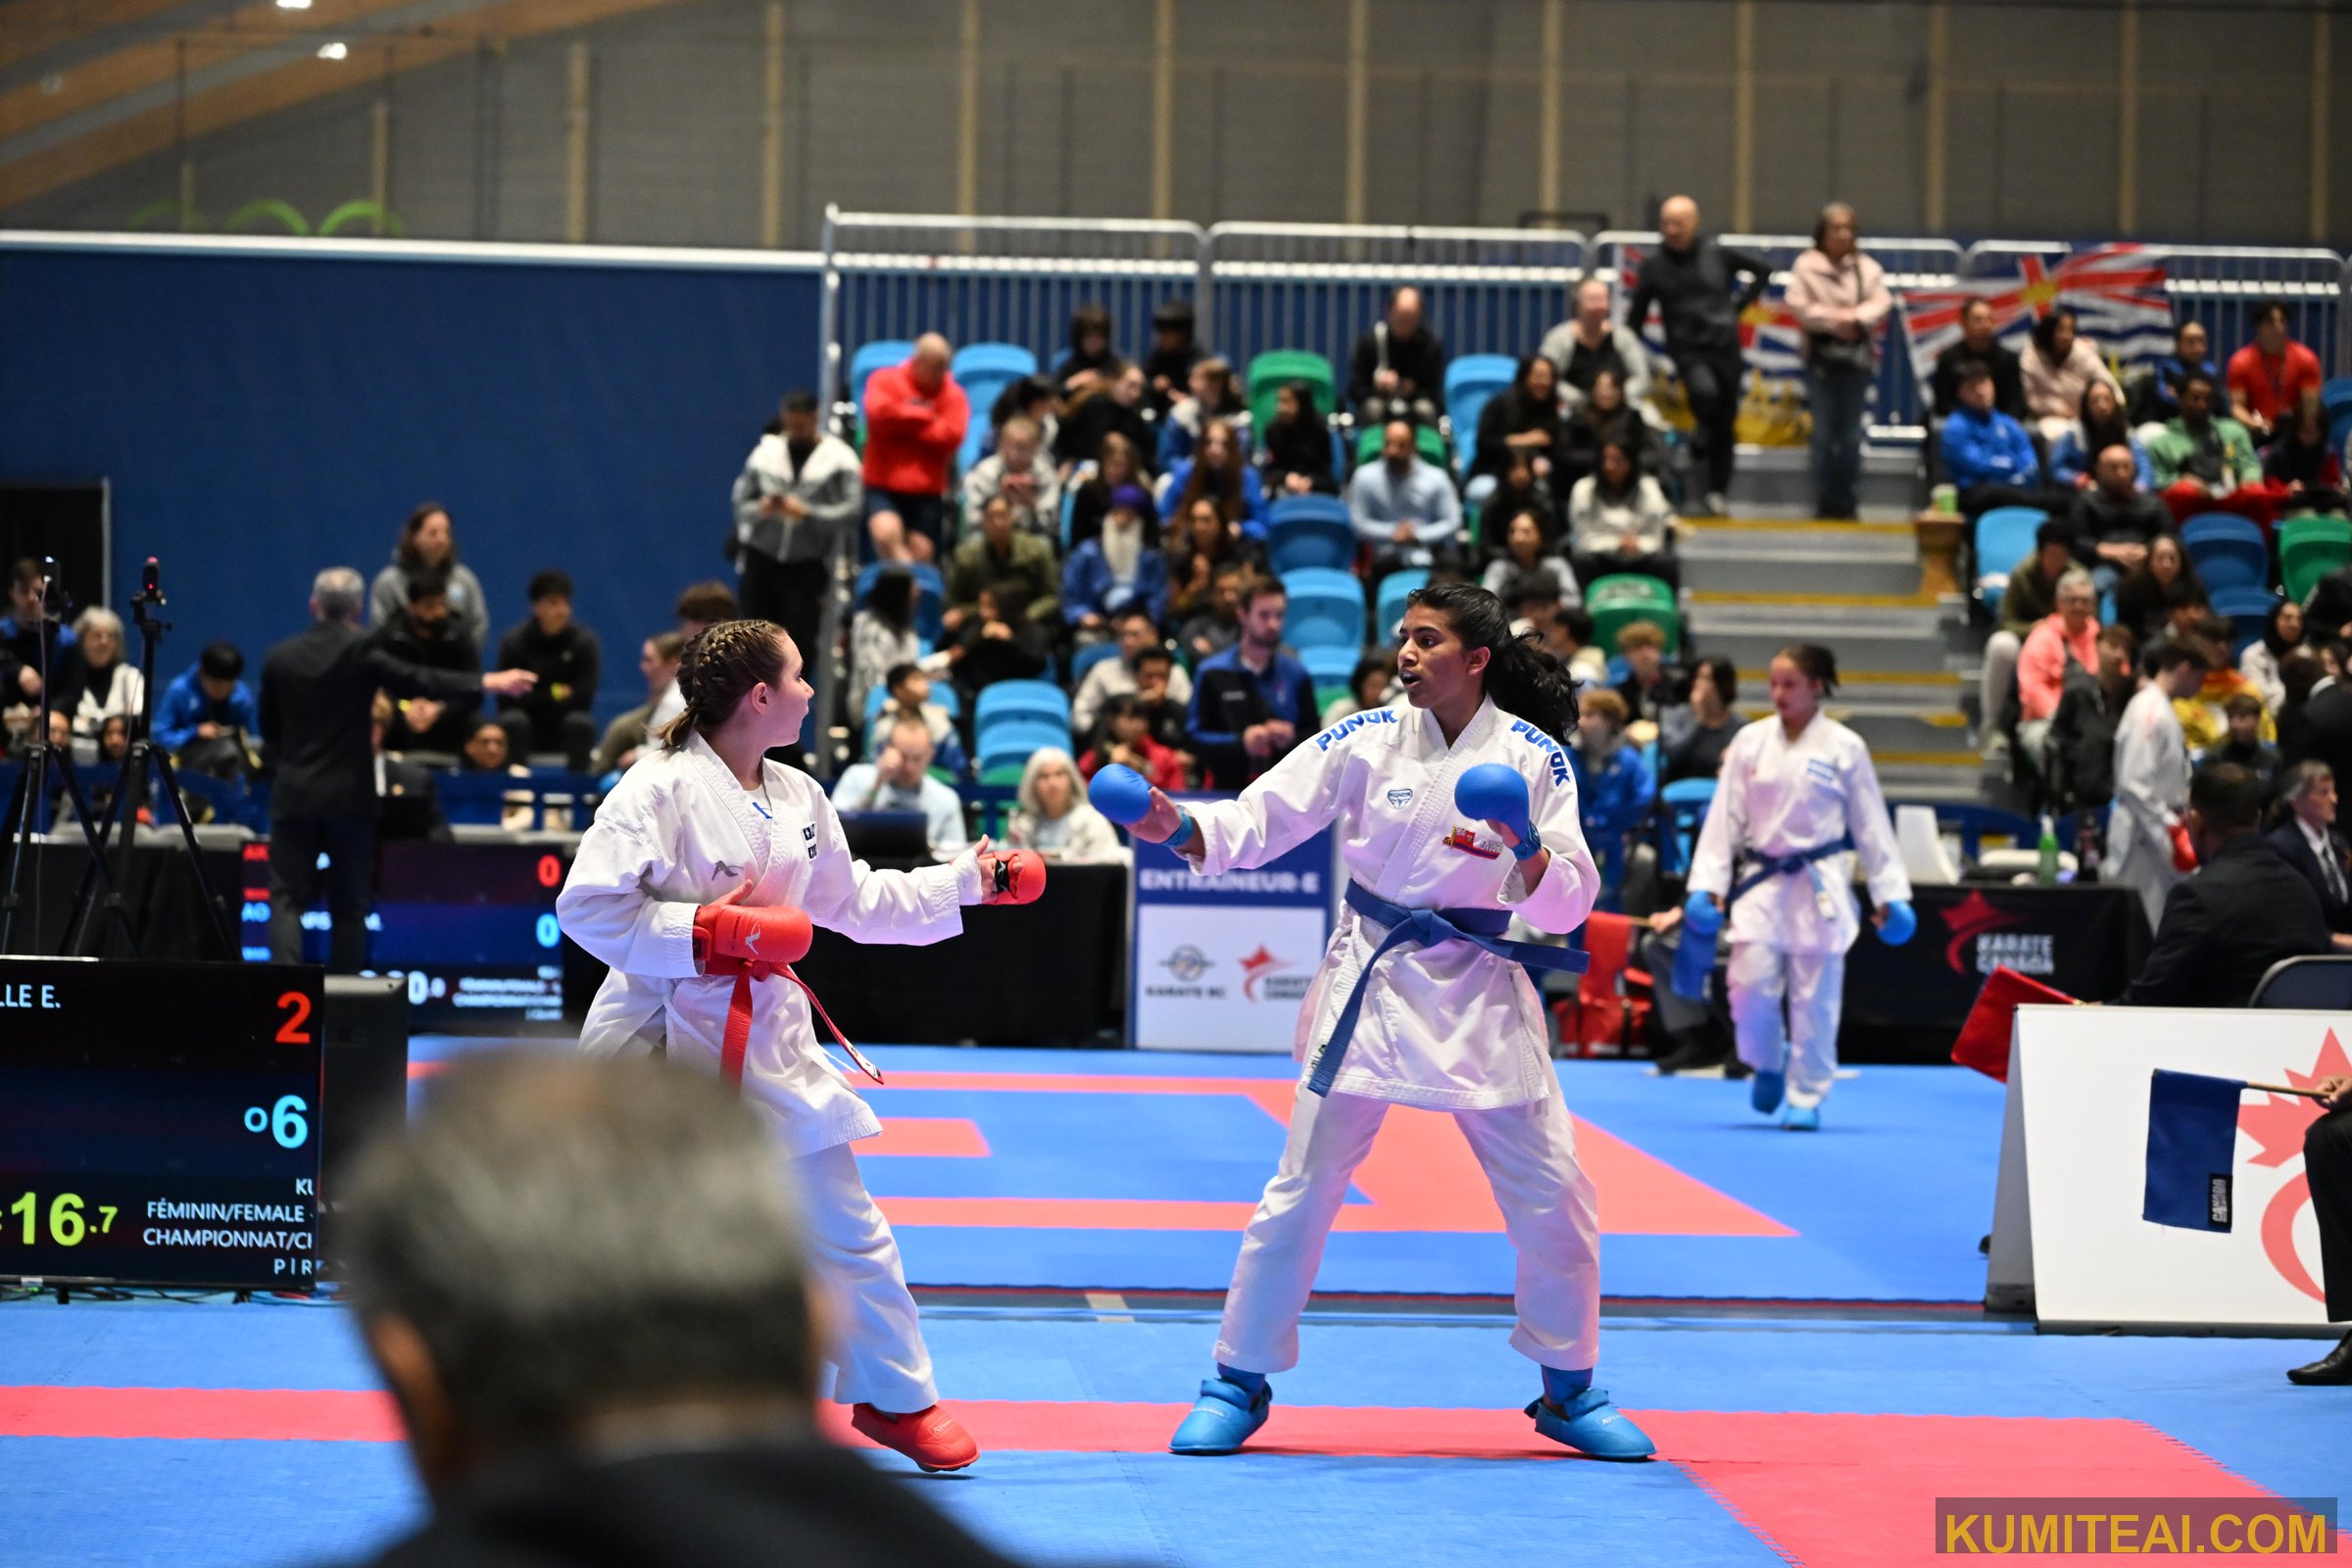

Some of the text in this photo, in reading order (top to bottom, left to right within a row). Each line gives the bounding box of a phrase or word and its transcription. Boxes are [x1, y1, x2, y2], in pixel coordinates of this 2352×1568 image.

[1316, 709, 1398, 752] PUNOK
[1510, 720, 1571, 788] PUNOK
[537, 854, 562, 887] 0
[536, 912, 562, 948] 0
[1976, 934, 2054, 954] KARATE
[41, 984, 61, 1008] E.
[274, 991, 311, 1044] 2
[147, 1198, 305, 1223] FÉMININ/FEMALE
